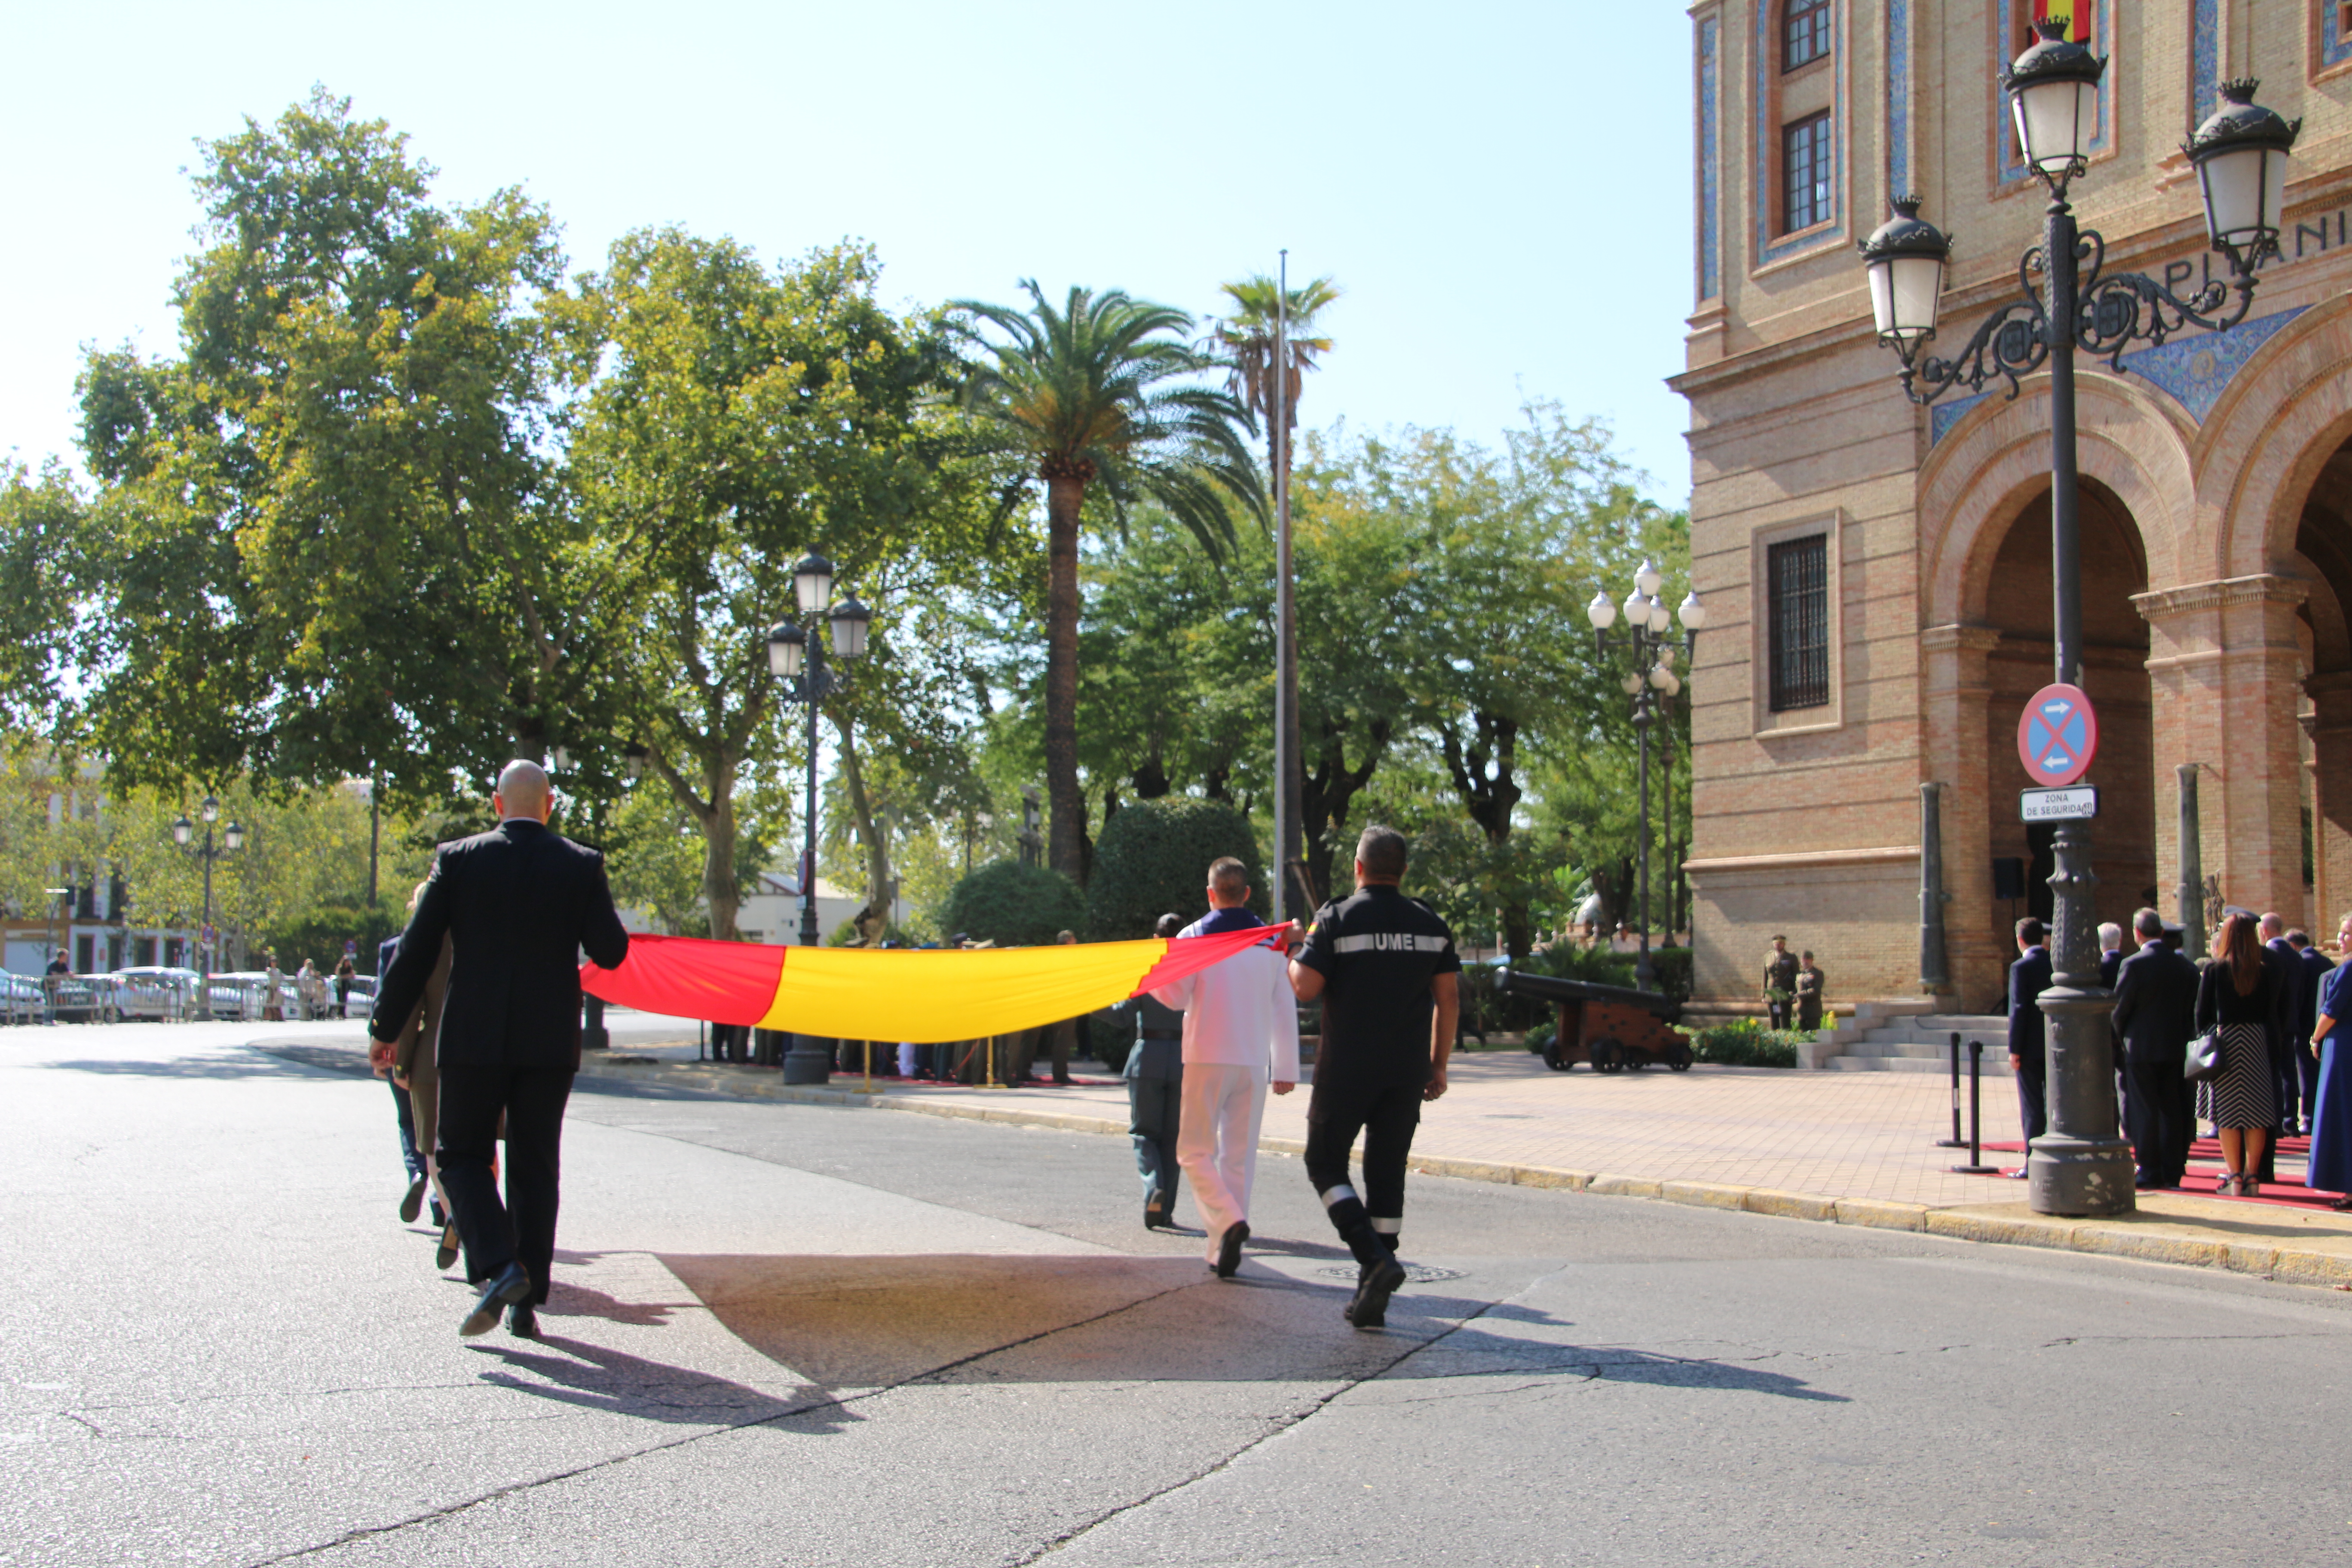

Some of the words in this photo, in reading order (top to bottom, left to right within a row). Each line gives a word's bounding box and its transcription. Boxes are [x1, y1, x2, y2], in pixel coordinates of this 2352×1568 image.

[2045, 793, 2068, 803] ZONA
[2026, 807, 2037, 815] DE
[2040, 804, 2090, 815] SEGURIDA
[1375, 933, 1414, 951] UME
